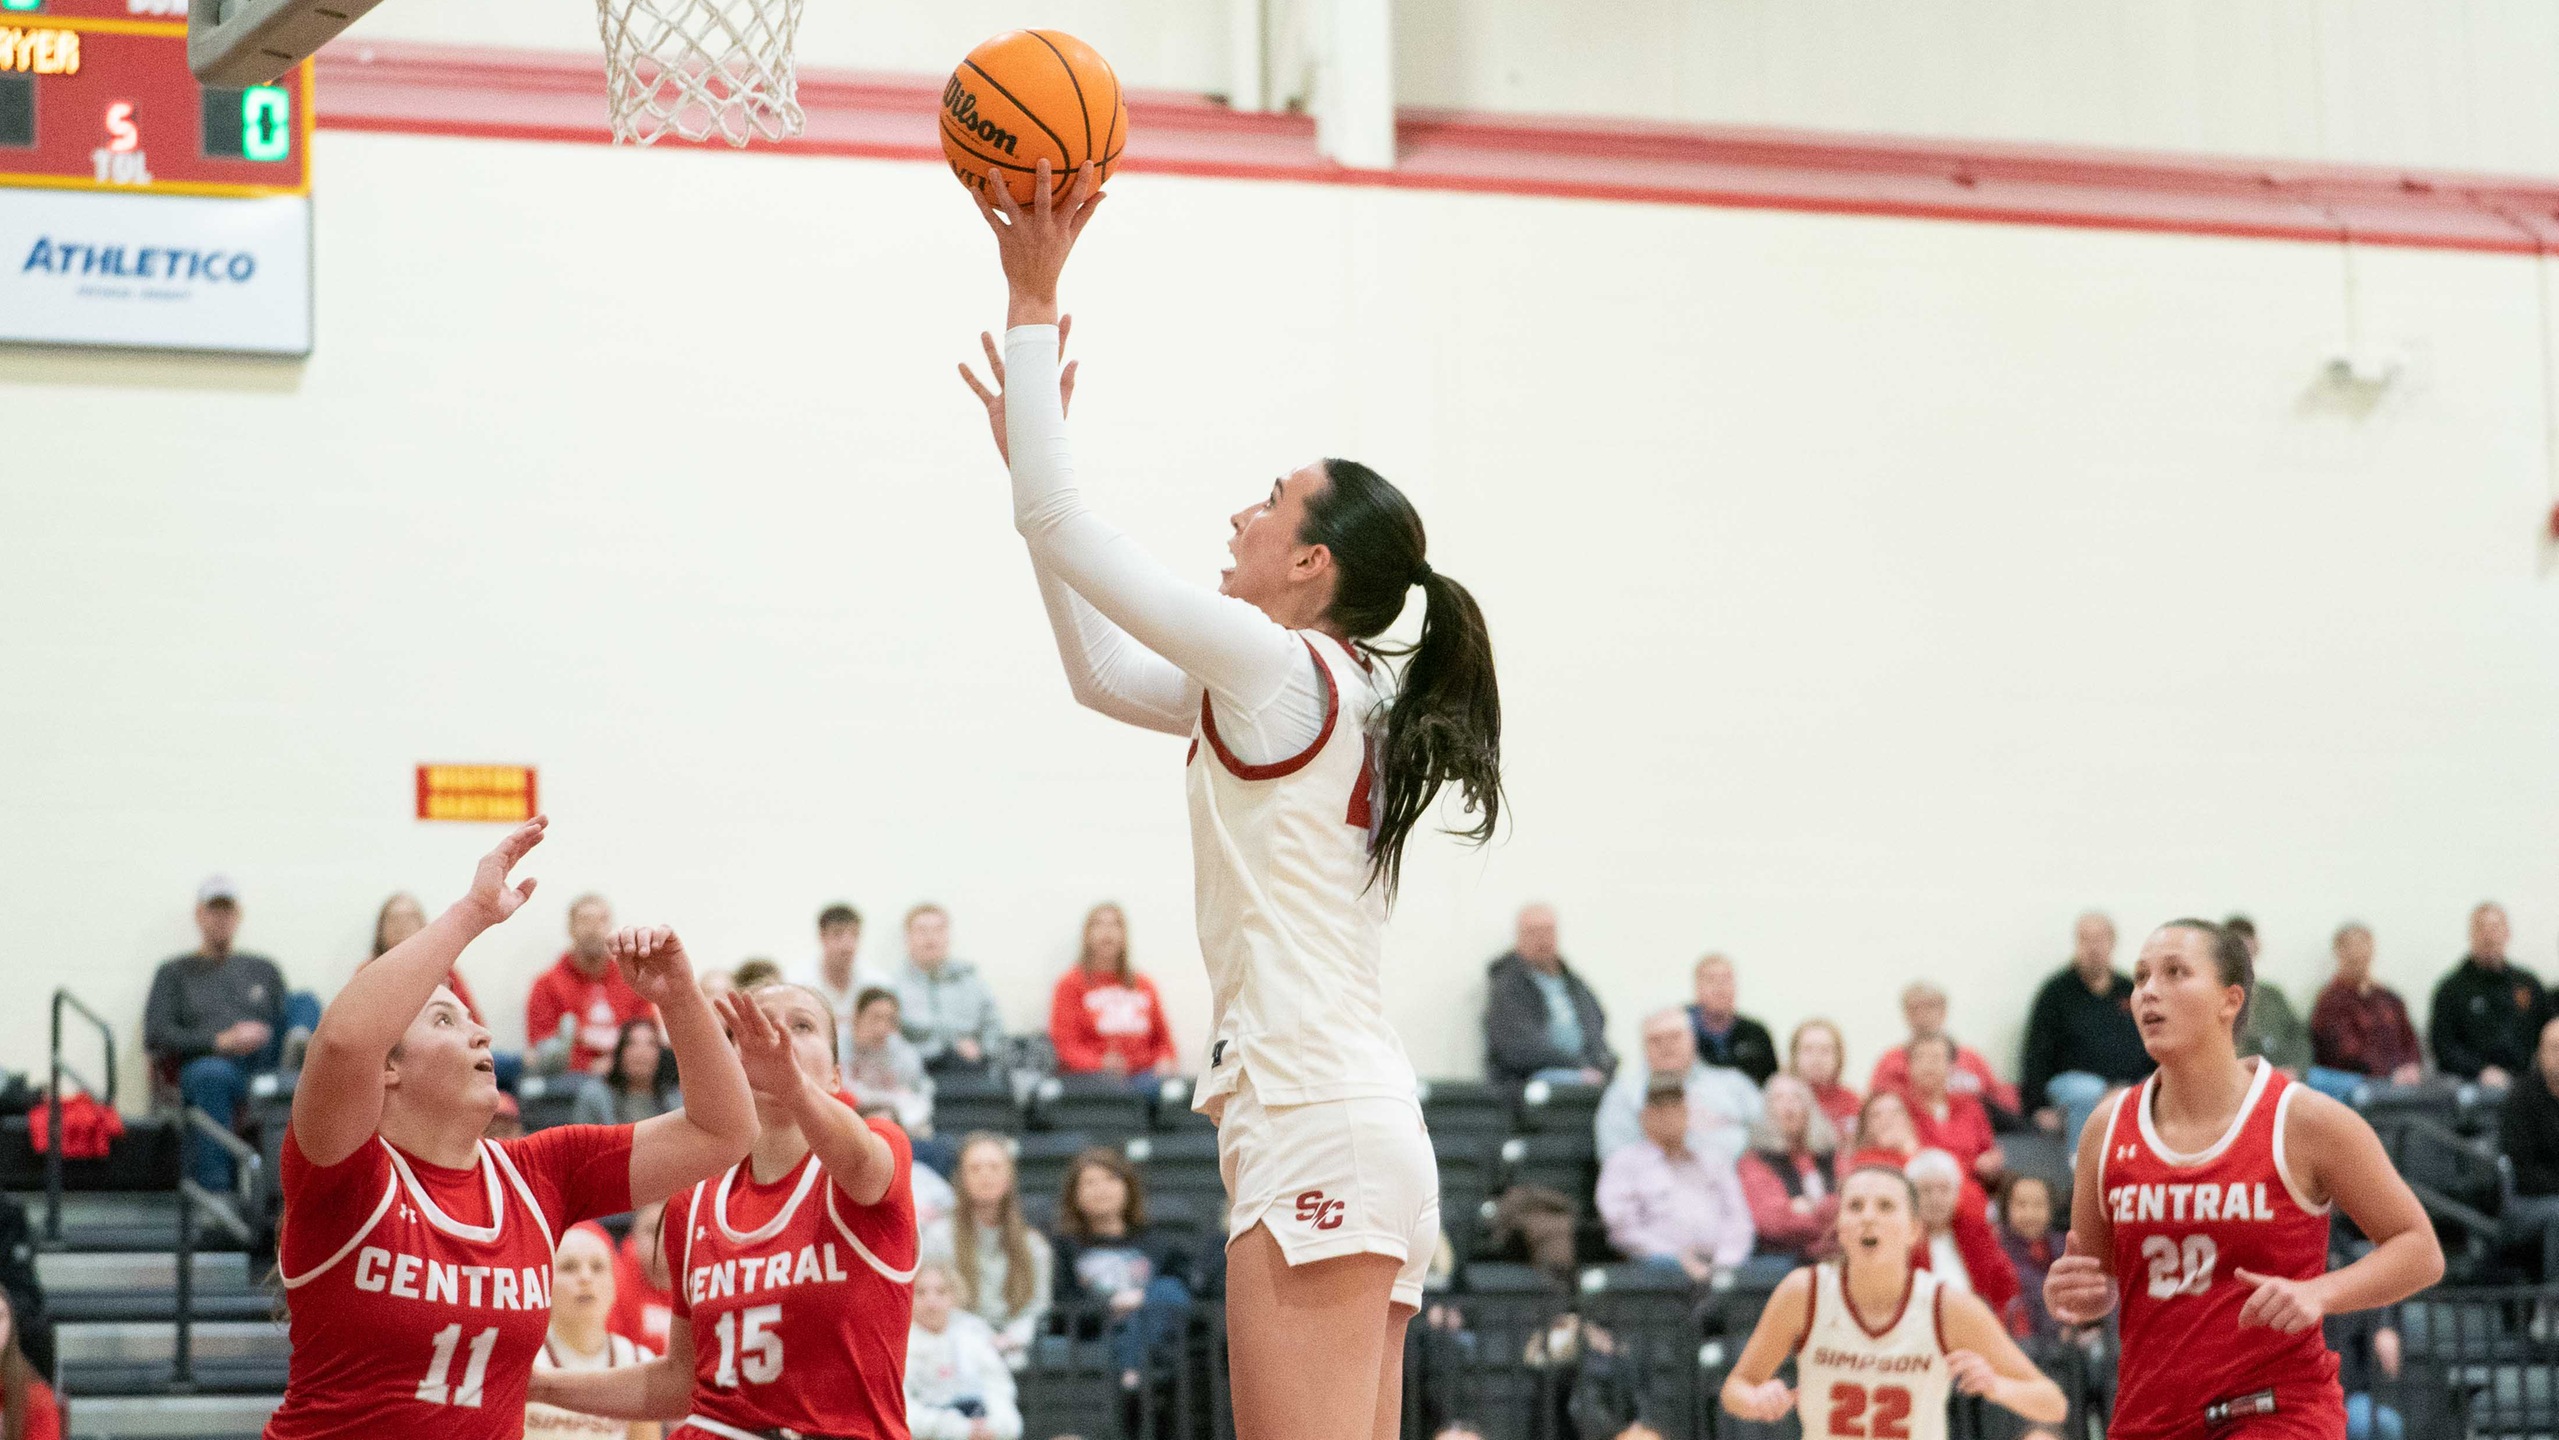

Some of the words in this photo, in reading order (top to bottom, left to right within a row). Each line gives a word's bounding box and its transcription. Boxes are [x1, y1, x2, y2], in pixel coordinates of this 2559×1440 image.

[243, 85, 290, 162] 0
[943, 72, 1018, 156] Wilson
[22, 235, 257, 284] ATHLETICO
[354, 1245, 551, 1310] CENTRAL
[690, 1242, 848, 1306] ENTRAL
[2141, 1234, 2218, 1299] 20
[414, 1322, 499, 1408] 11
[714, 1303, 784, 1388] 15
[1813, 1346, 1932, 1373] SIMPSON
[1828, 1381, 1912, 1439] 22
